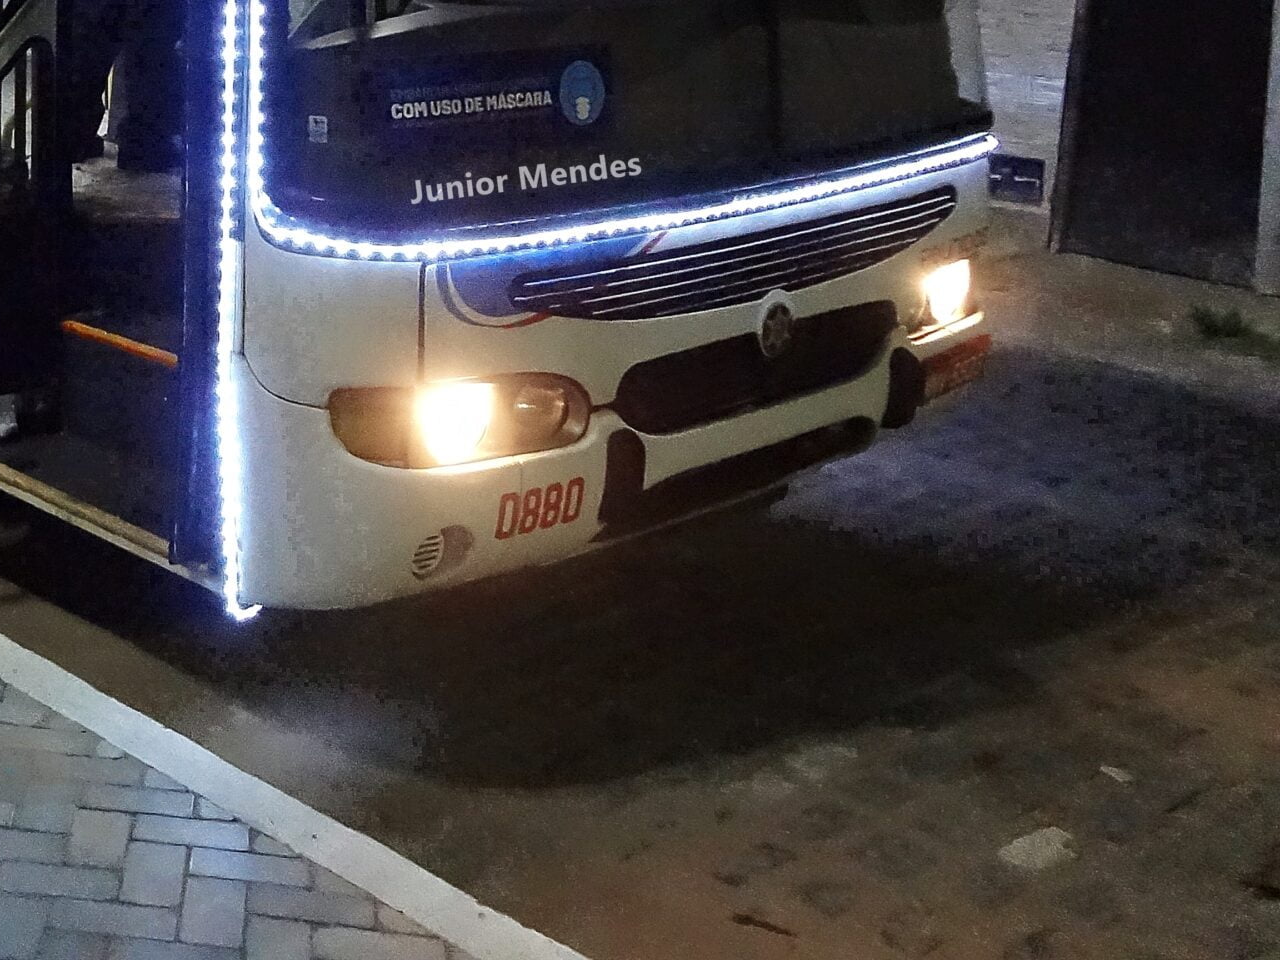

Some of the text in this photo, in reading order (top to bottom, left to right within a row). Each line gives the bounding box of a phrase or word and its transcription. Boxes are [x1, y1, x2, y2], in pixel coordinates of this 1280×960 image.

[391, 101, 428, 120] COM
[430, 99, 462, 116] USO
[465, 96, 484, 114] DE
